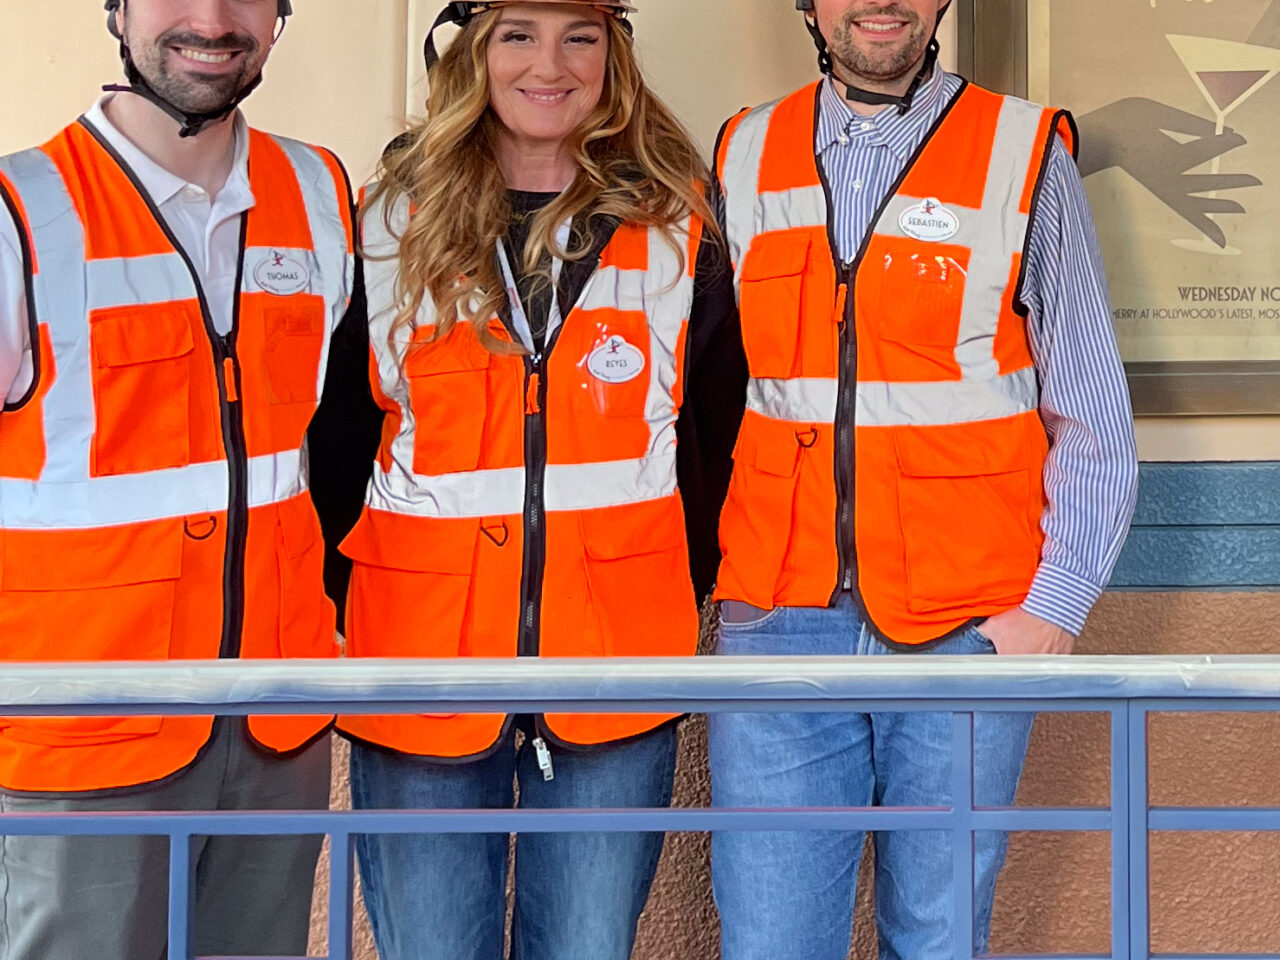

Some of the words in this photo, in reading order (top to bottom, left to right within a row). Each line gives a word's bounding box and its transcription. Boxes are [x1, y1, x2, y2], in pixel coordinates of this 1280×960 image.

[907, 216, 949, 229] SEBASTIEN
[267, 272, 299, 281] THOMAS
[1178, 286, 1256, 301] WEDNESDAY
[1140, 308, 1150, 320] AT
[1152, 308, 1224, 320] HOLLYWOOD'S
[1226, 308, 1256, 320] LATEST,
[605, 360, 628, 368] REYES
